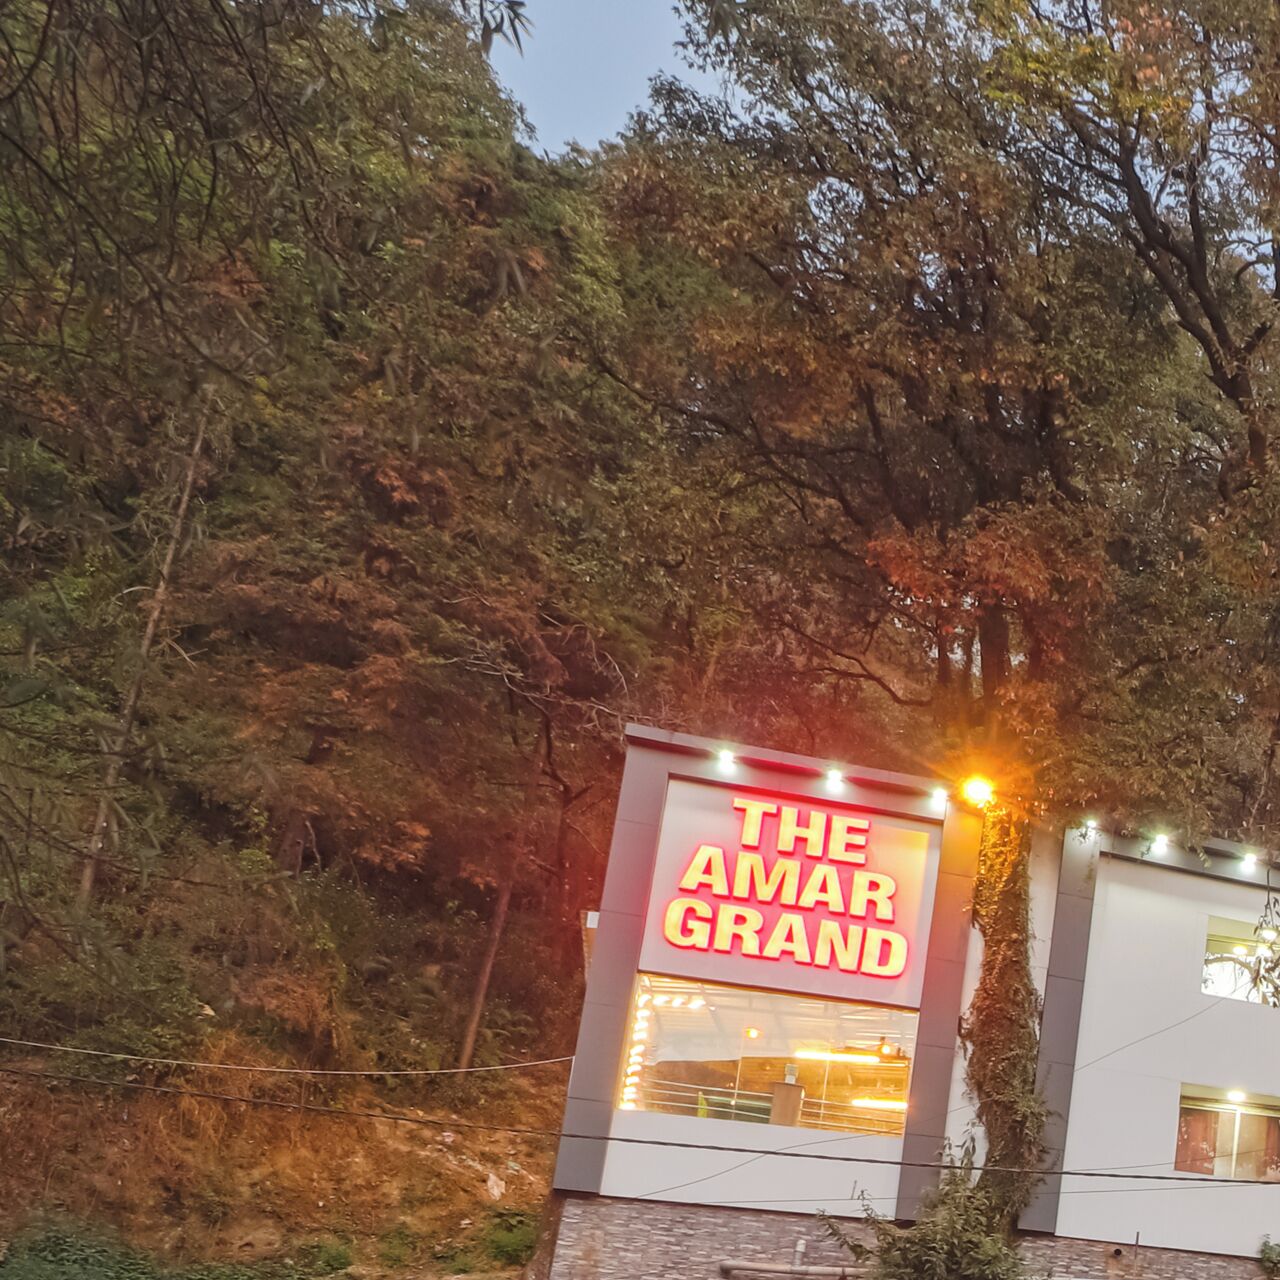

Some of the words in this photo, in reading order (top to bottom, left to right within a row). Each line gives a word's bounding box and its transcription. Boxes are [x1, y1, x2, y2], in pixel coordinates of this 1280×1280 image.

[733, 797, 870, 865] THE
[678, 845, 897, 922] AMAR
[663, 898, 909, 978] GRAND
